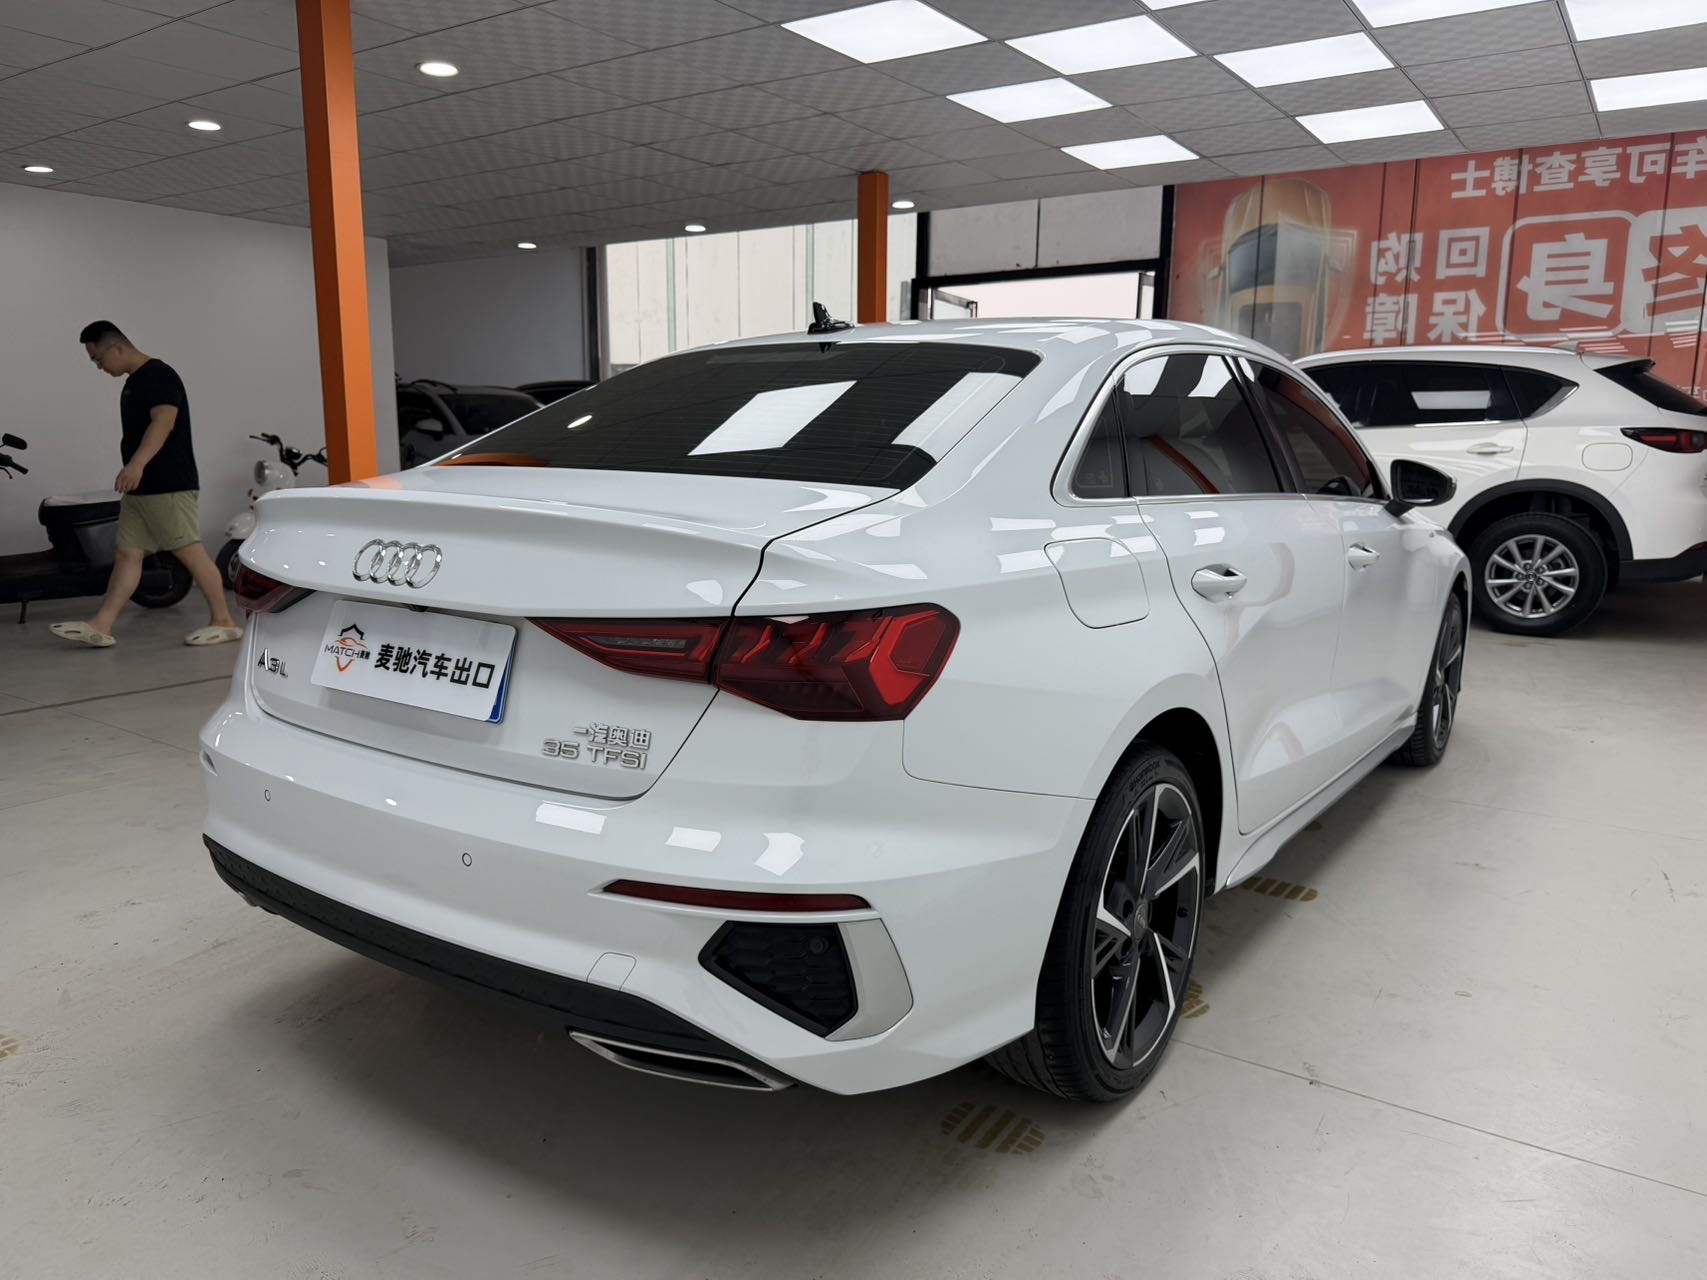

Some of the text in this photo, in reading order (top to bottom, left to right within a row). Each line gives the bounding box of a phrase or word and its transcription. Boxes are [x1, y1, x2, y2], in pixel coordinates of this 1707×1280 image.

[257, 648, 288, 679] A3L
[374, 643, 496, 689] 麦驰汽车出口
[573, 721, 652, 750] 一汽奥迪
[542, 738, 648, 770] 35 TFSI
